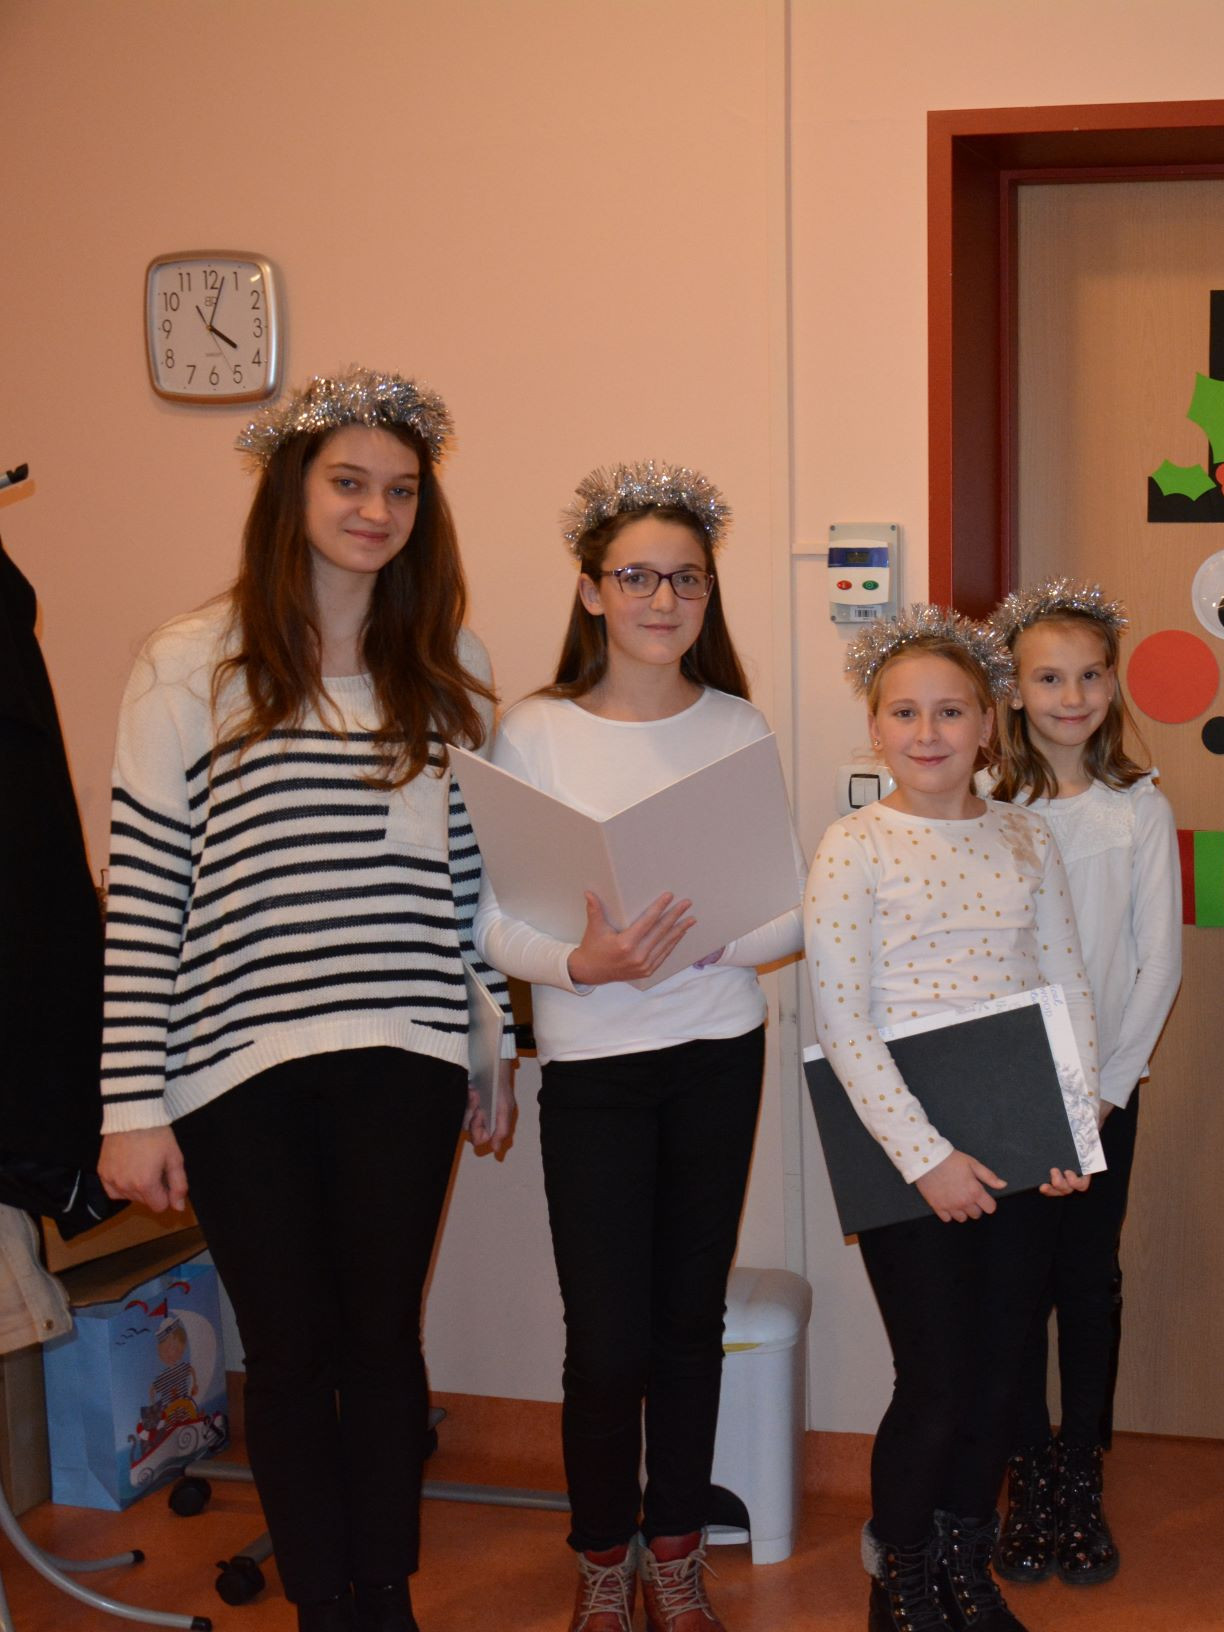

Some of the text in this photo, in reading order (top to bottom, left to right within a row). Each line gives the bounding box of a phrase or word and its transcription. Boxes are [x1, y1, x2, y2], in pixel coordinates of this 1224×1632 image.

[178, 272, 191, 292] 11
[202, 270, 218, 290] 12
[233, 271, 239, 291] 1
[163, 292, 180, 312] 10
[250, 290, 261, 310] 2
[162, 319, 172, 339] 9
[253, 317, 263, 338] 3
[165, 348, 175, 369] 8
[251, 350, 262, 367] 4
[187, 365, 196, 385] 7
[209, 366, 219, 386] 6
[232, 365, 243, 384] 5
